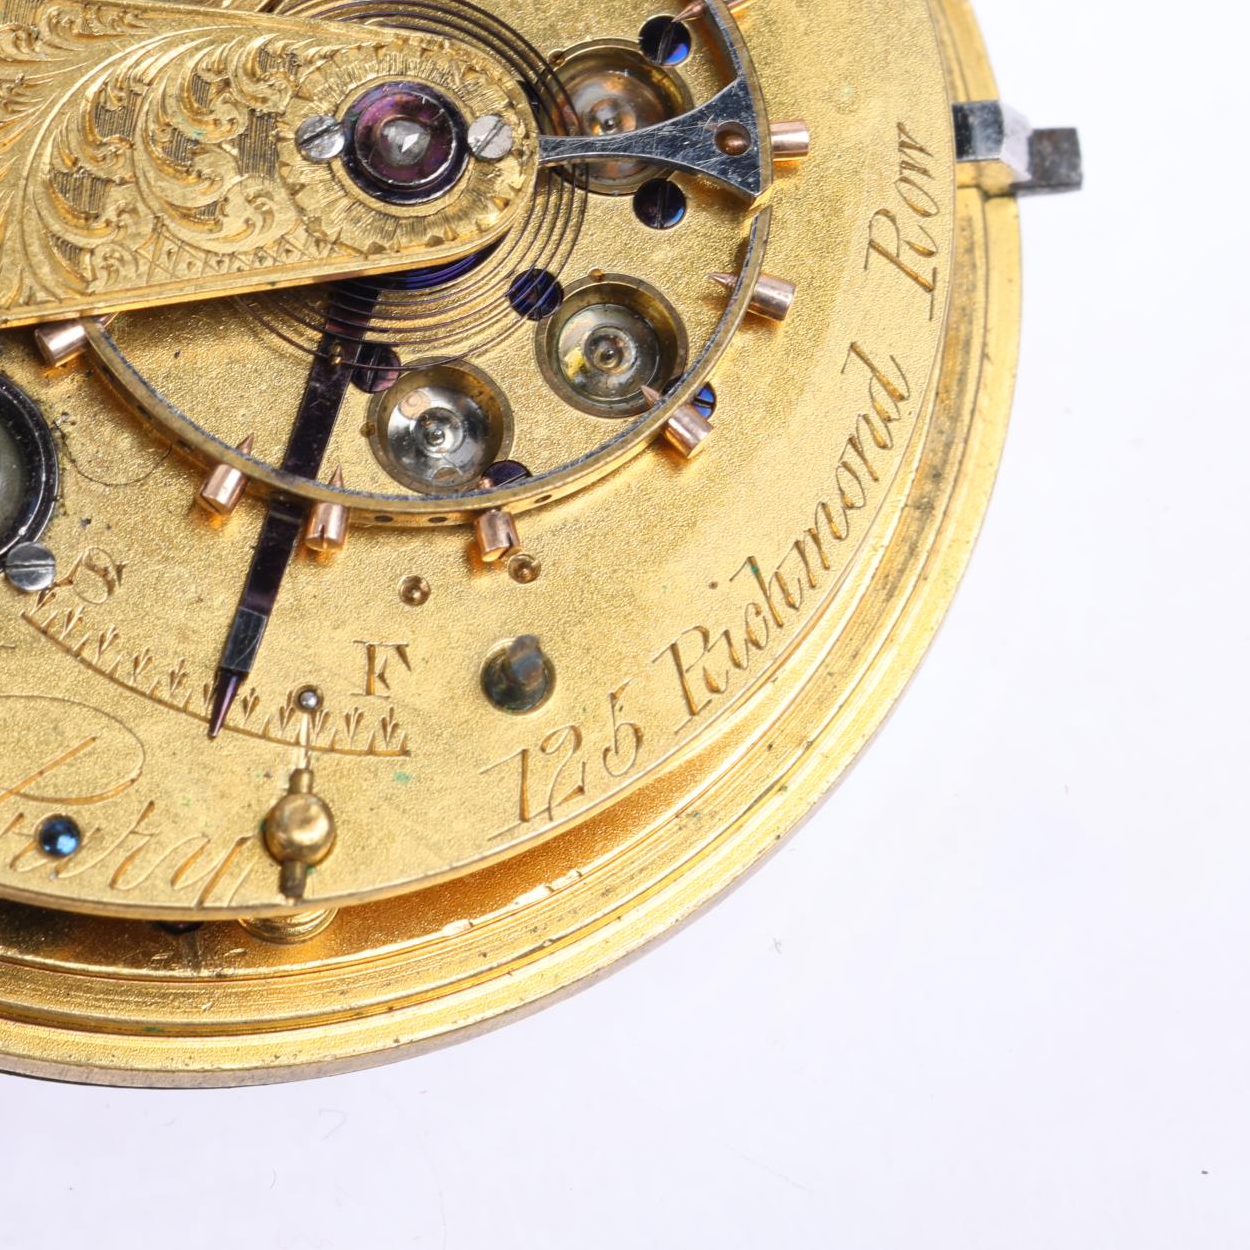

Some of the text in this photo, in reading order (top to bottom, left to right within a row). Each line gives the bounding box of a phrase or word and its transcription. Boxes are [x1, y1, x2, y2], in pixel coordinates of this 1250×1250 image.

[351, 639, 411, 700] F
[479, 123, 940, 840] 125 Richmond Row
